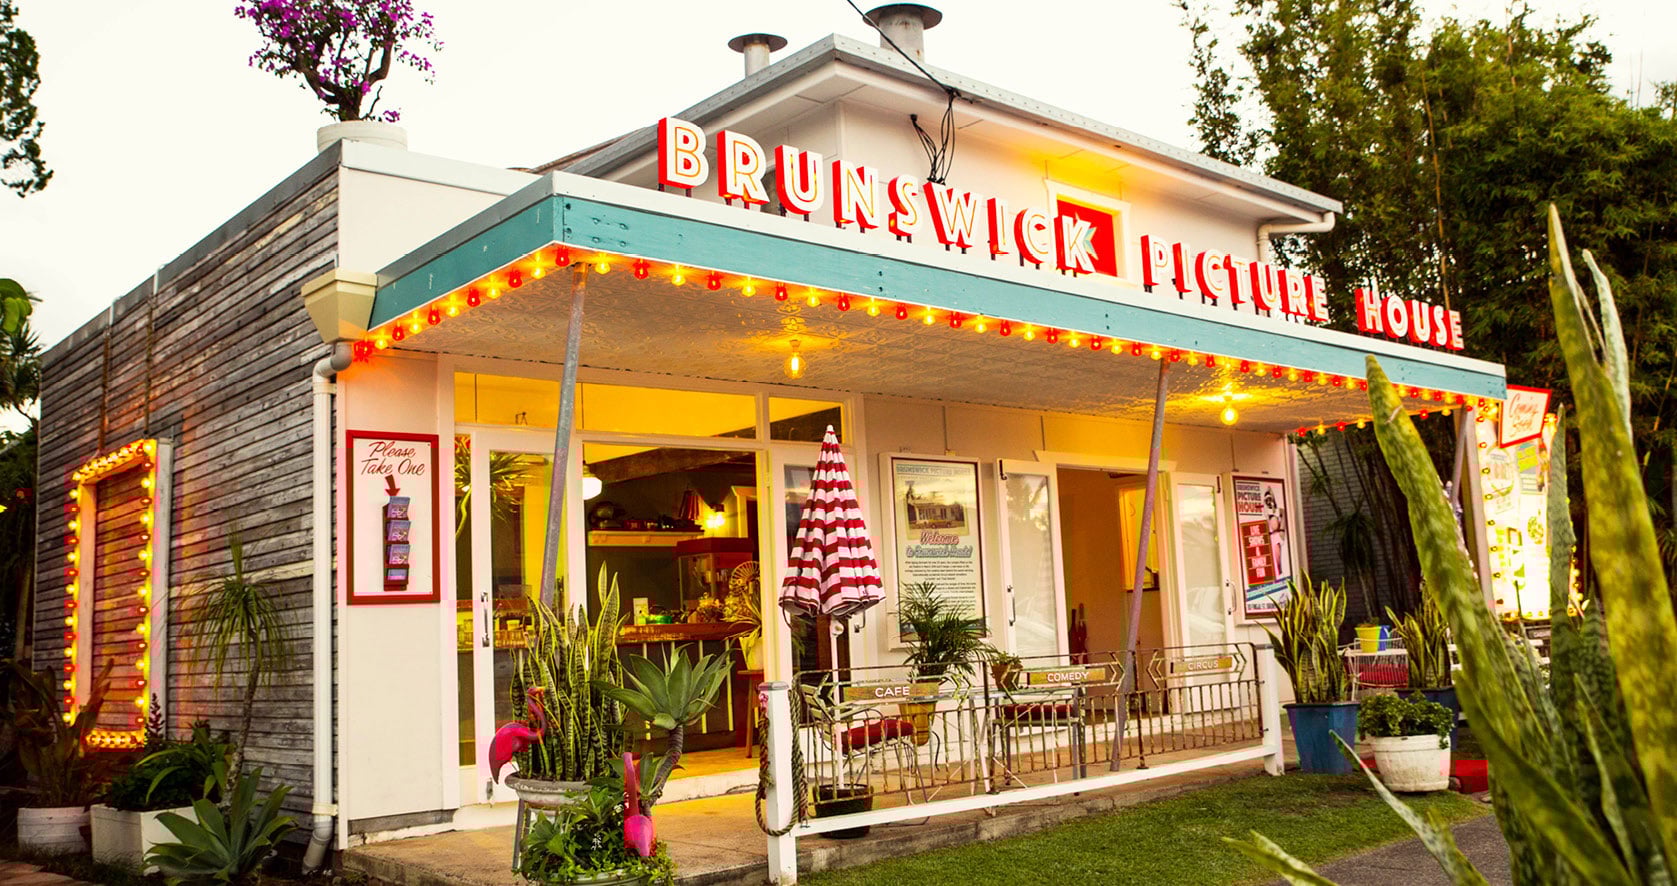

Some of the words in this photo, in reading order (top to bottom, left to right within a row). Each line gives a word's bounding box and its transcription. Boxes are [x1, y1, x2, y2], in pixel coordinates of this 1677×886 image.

[658, 117, 1096, 275] BRUNSWICK
[1141, 233, 1329, 323] PICTURE
[1355, 287, 1465, 351] HOUSE
[368, 441, 416, 458] Please
[360, 458, 393, 476] Take
[397, 458, 425, 476] One
[1237, 491, 1261, 501] PICTURE
[1238, 501, 1263, 513] HOUSE
[920, 531, 959, 545] Welcome
[1188, 660, 1219, 671] CIRCUS
[1047, 671, 1089, 682] COMEDY
[875, 686, 911, 697] CAFE
